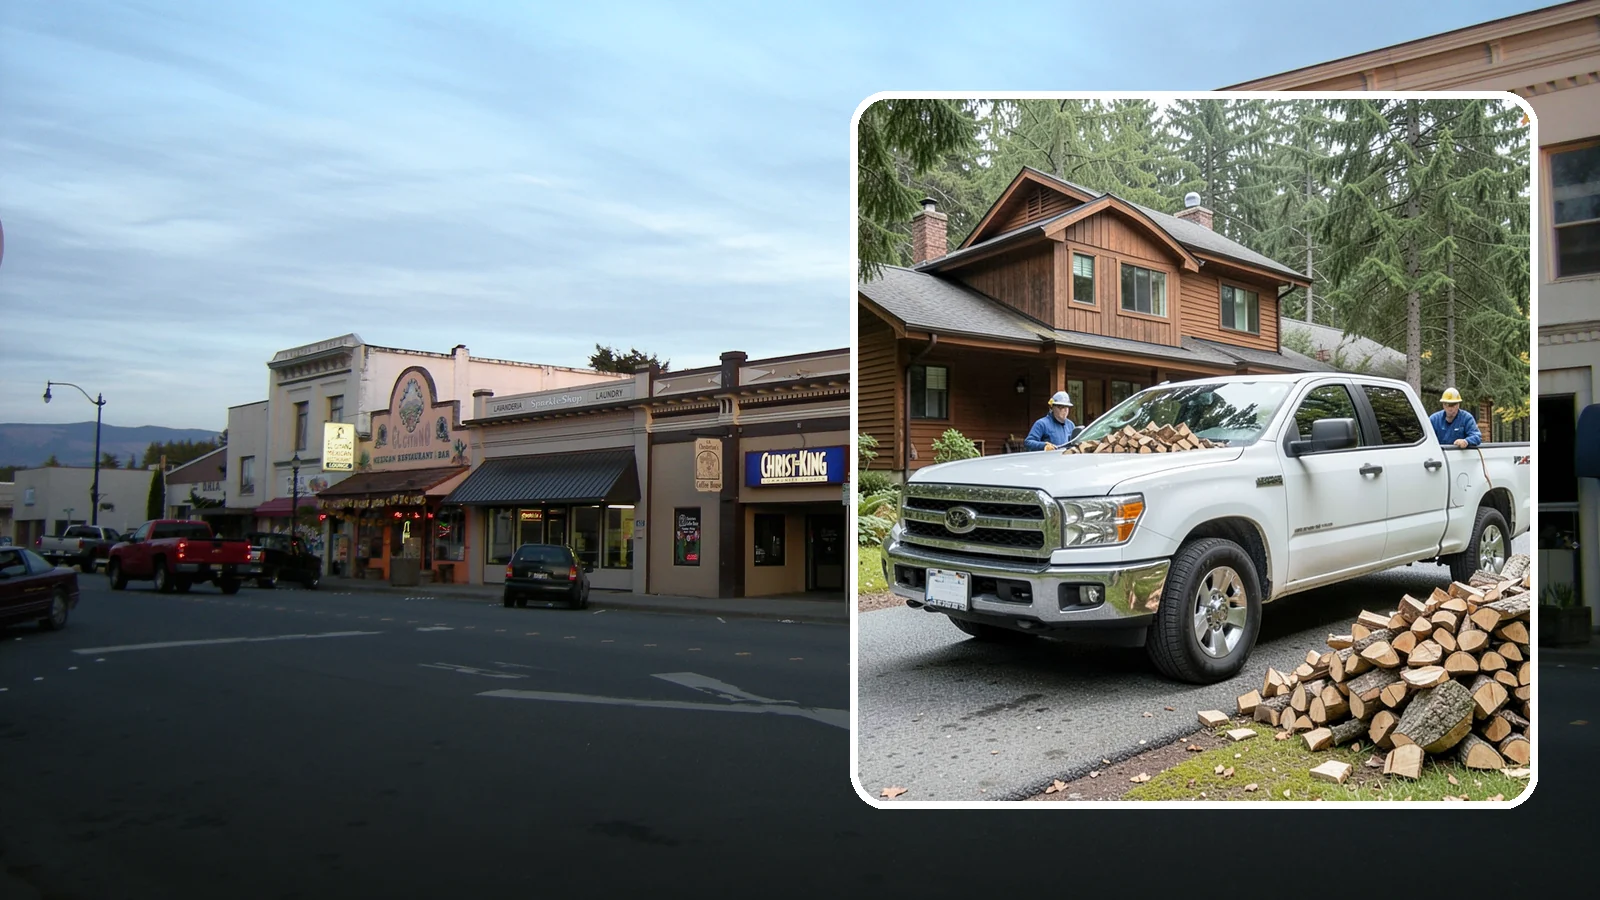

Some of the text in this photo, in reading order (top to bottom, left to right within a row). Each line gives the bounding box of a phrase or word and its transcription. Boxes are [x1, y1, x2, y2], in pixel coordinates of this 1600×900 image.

[561, 394, 582, 406] Shop
[595, 388, 623, 400] LAUNDRY
[493, 402, 522, 413] LAVANDERIA
[373, 450, 450, 464] MEXICAN RESTAURANT BAR
[761, 450, 827, 478] CHRIST KING
[696, 481, 722, 489] Coffee House
